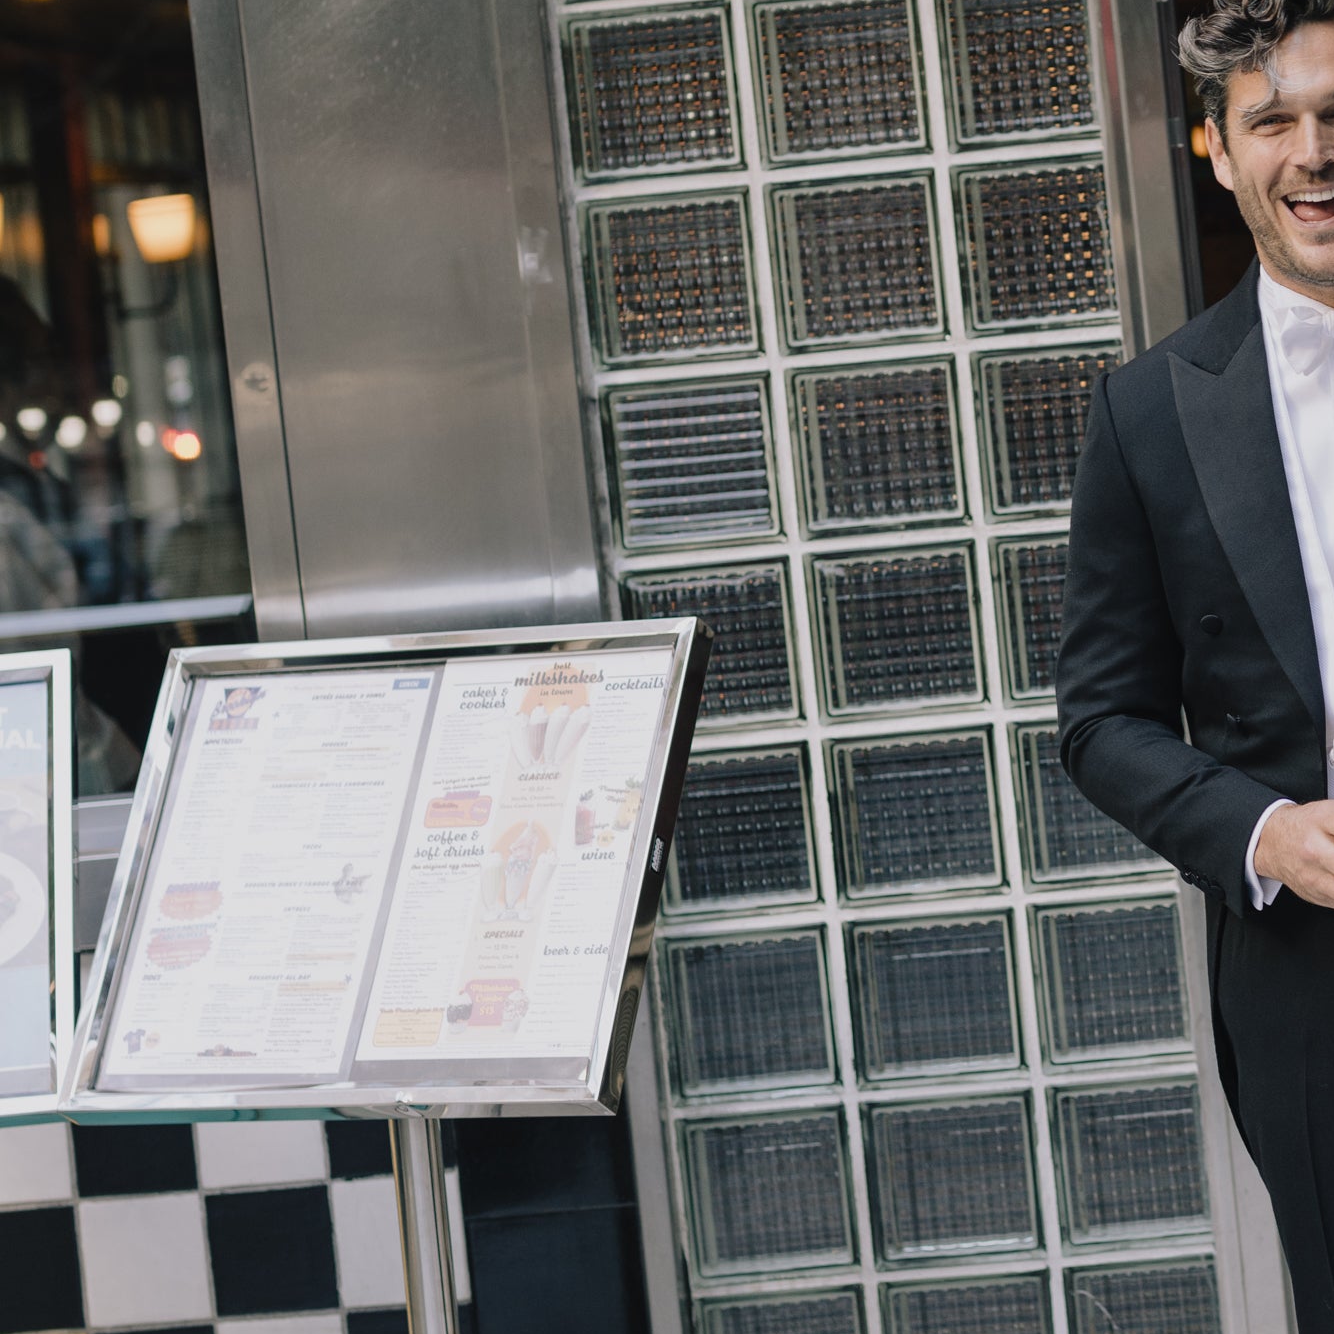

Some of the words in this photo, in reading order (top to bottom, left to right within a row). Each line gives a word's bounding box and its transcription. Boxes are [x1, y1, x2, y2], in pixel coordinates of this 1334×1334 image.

[553, 662, 571, 670] best
[514, 669, 605, 687] milkshakes
[605, 676, 665, 691] cocktails
[462, 686, 497, 698] cakes
[501, 687, 509, 696] &
[459, 697, 506, 710] cookies
[518, 771, 560, 781] CLASSICS
[427, 830, 468, 844] coffee
[471, 830, 479, 841] &
[414, 846, 440, 860] soft
[443, 844, 485, 858] drinks
[581, 848, 616, 860] wine
[483, 930, 525, 939] SPECIALS
[543, 944, 570, 956] beer
[573, 946, 580, 955] &
[583, 943, 609, 955] cide
